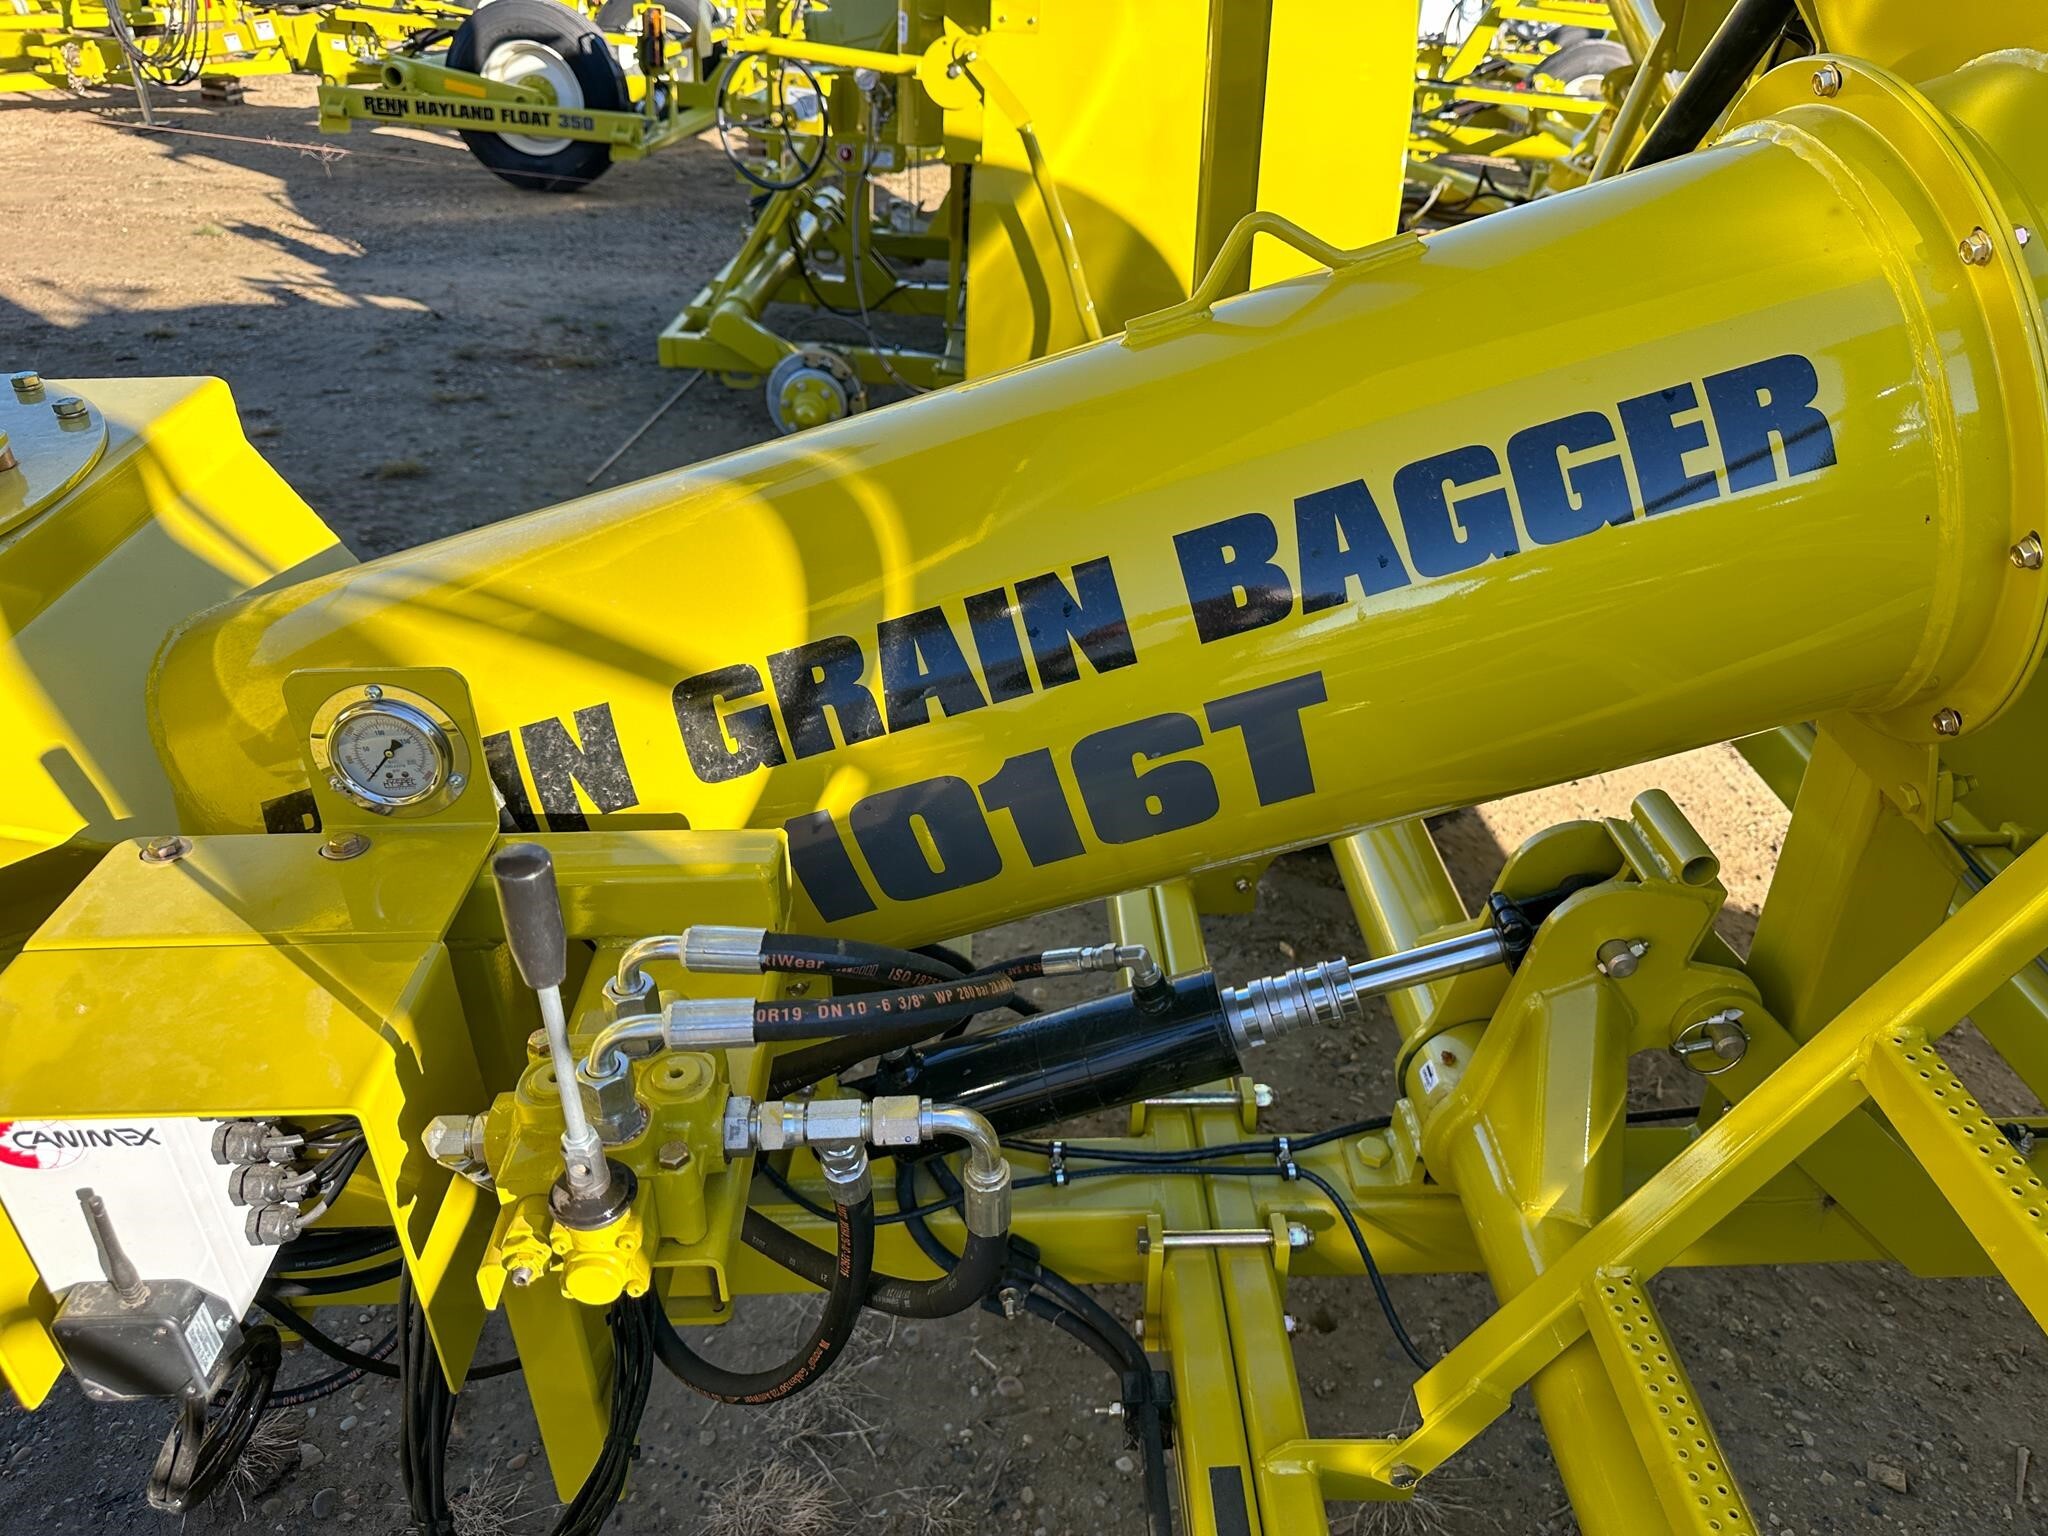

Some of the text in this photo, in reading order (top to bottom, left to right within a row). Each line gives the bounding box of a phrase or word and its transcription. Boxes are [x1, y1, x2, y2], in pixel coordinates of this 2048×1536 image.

[363, 96, 594, 131] RENN HAYLAND FLOAT 350
[671, 556, 1138, 784] GRAIN
[1172, 354, 1837, 645] BAGGER
[787, 671, 1327, 923] 1016T
[818, 1003, 844, 1020] DN
[850, 1001, 867, 1016] 10
[876, 998, 891, 1013] -6
[899, 993, 926, 1011] 3/8"
[934, 989, 953, 1005] WP
[957, 986, 974, 1000] 280
[974, 984, 988, 998] bar
[12, 1127, 161, 1150] CANIMEX
